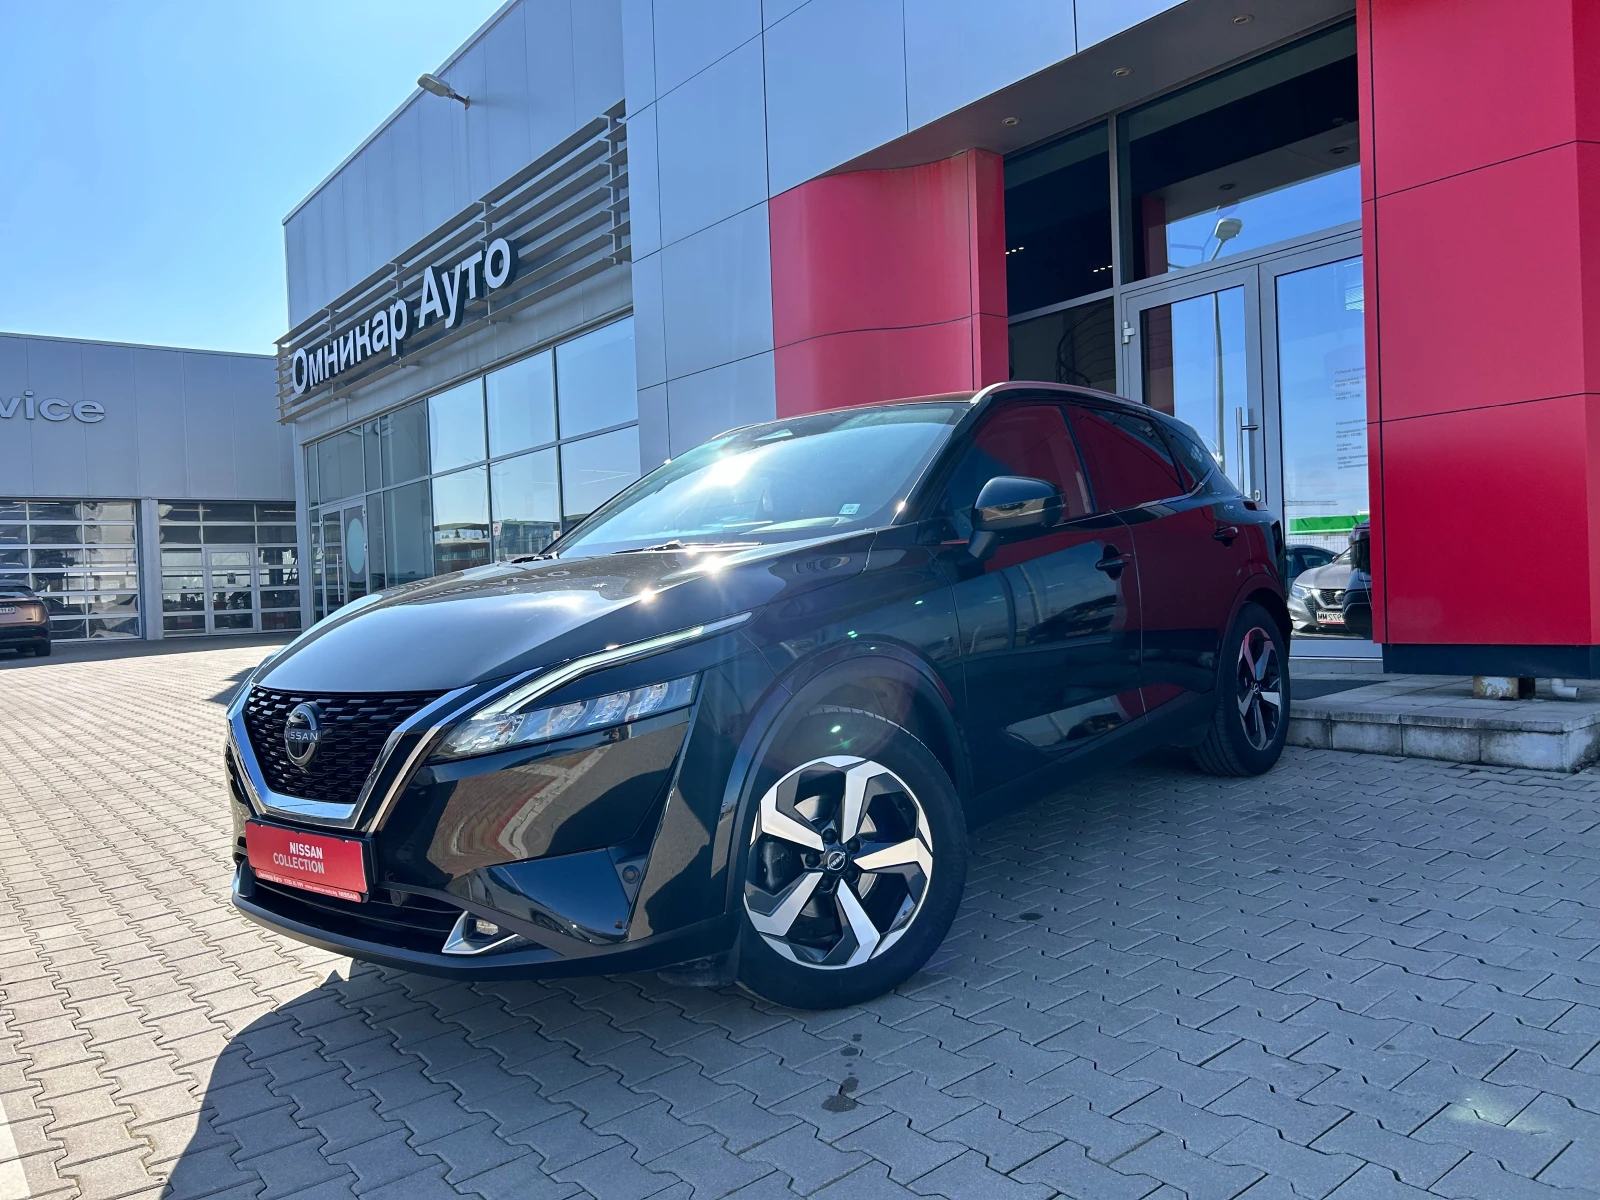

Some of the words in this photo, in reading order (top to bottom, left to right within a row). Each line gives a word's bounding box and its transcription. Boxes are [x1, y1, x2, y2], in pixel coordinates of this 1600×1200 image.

[292, 298, 408, 395] Омникар
[418, 237, 512, 329] Ауто
[0, 390, 105, 423] vice
[273, 852, 325, 875] COLLECTION
[290, 842, 323, 859] NISSAN
